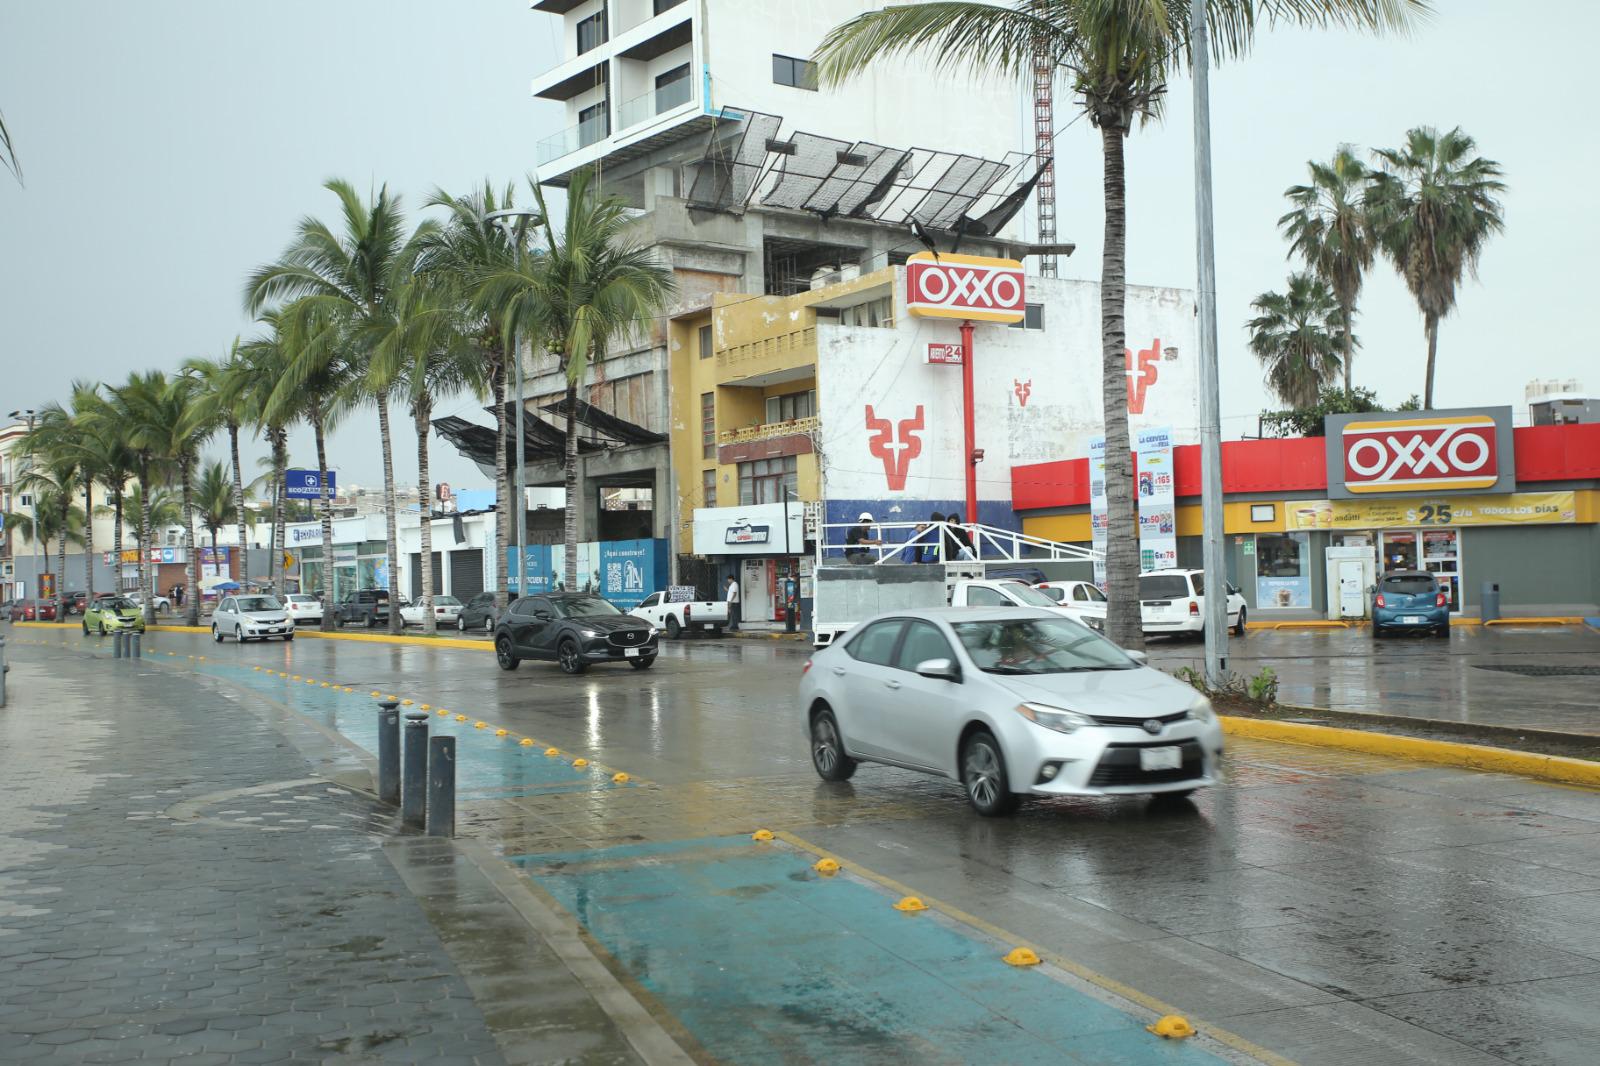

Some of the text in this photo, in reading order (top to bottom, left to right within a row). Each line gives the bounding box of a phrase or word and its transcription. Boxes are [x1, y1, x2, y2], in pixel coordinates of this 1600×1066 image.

[918, 266, 1021, 308] OXXO
[946, 346, 962, 358] 24
[1146, 435, 1168, 443] CERVEZA
[1347, 431, 1490, 481] OXXO
[1478, 506, 1512, 515] TODOS
[1513, 505, 1533, 514] LOS
[1535, 504, 1559, 513] DÍAS
[1334, 513, 1360, 521] andatti
